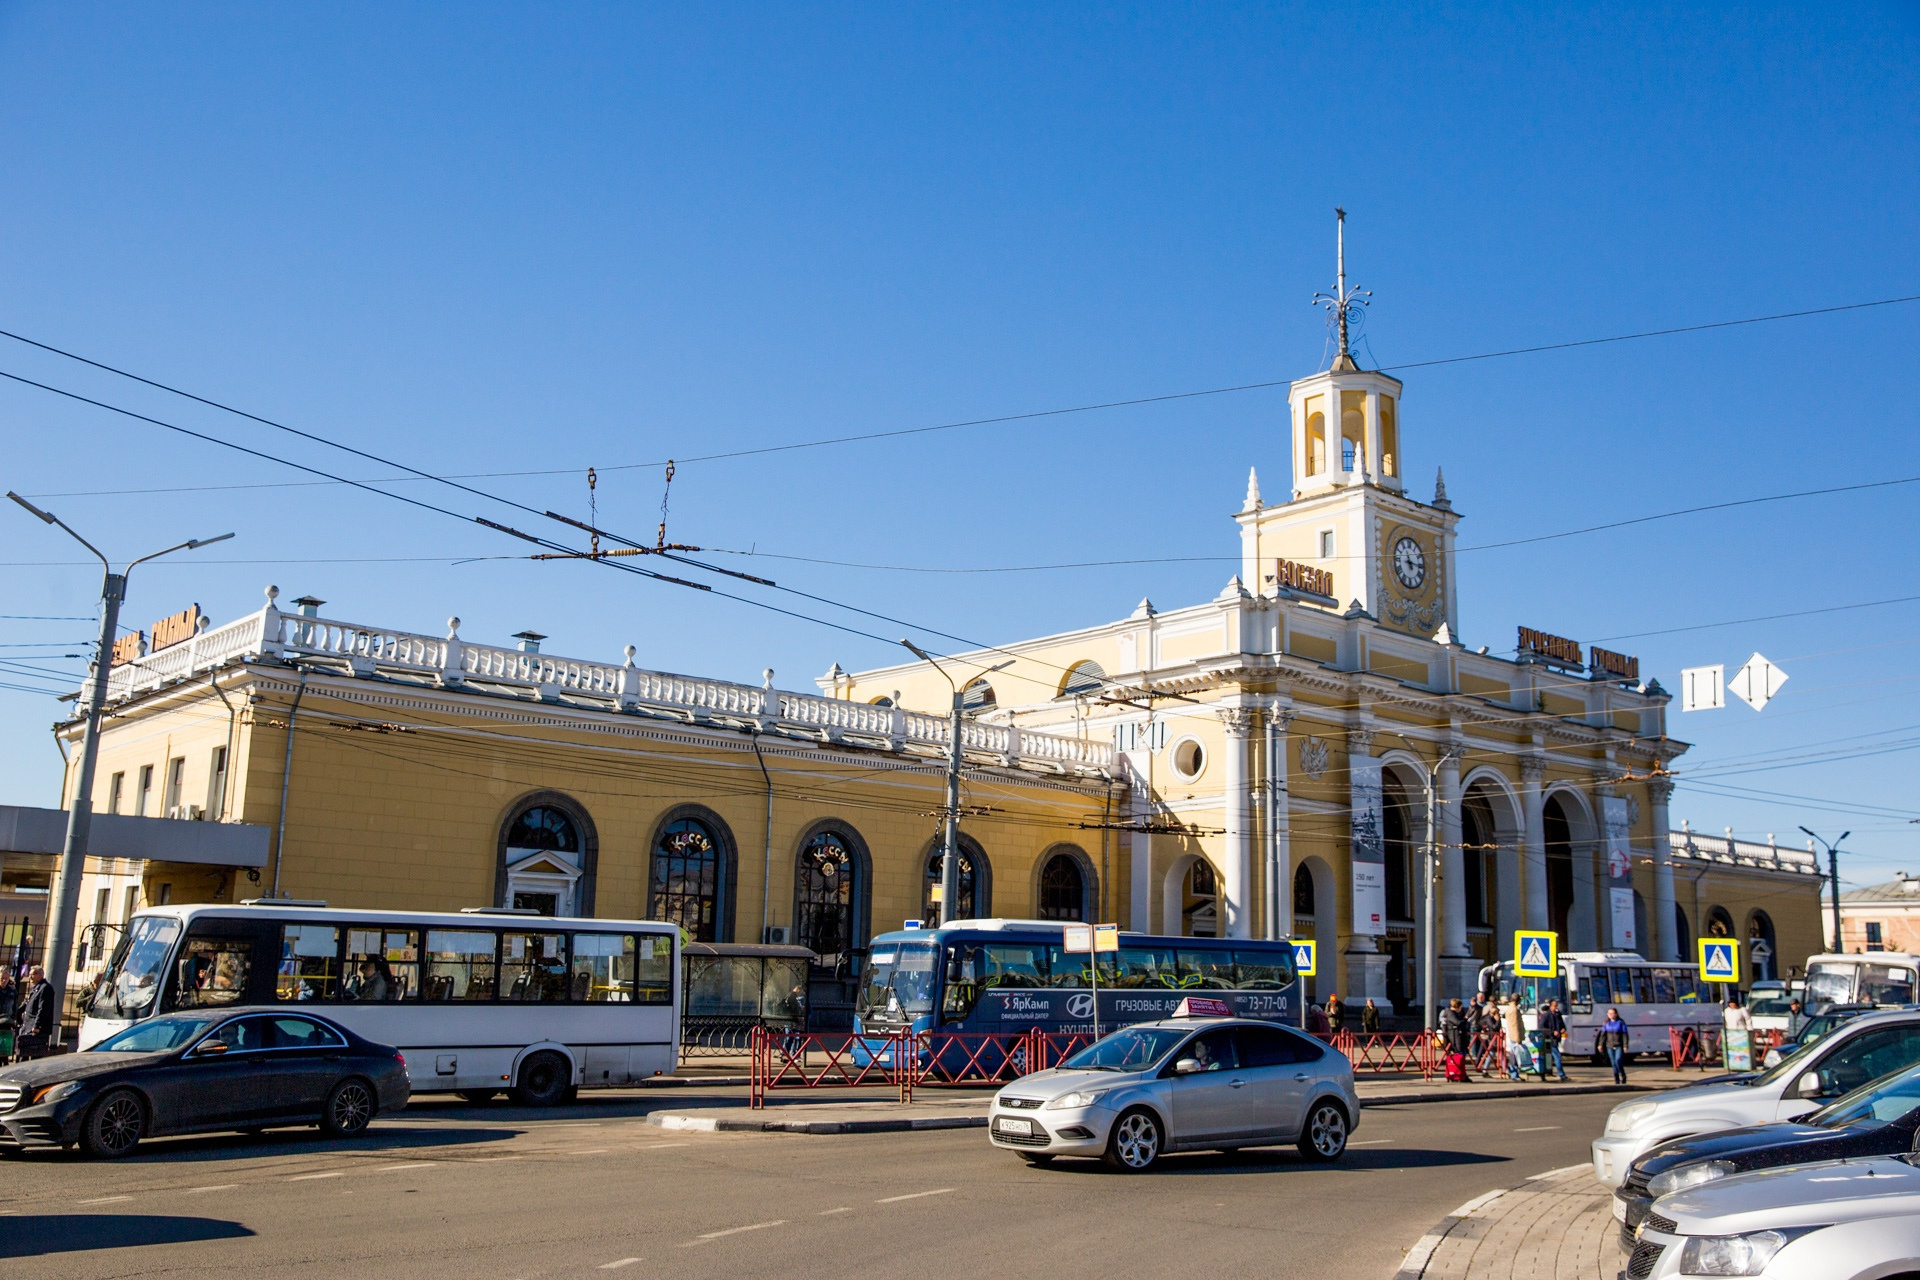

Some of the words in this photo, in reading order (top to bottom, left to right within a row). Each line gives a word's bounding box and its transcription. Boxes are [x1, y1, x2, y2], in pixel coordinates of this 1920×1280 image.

[1276, 557, 1334, 597] ВОКЗАЛ
[1012, 997, 1049, 1011] ЯрКамп
[1115, 1000, 1163, 1012] ГРУЗОВЫЕ
[1249, 996, 1287, 1010] 73-77-00
[1001, 1012, 1034, 1020] ОФИЦИАЛЬНЫЙ
[1034, 1012, 1050, 1020] ДИЛЕР
